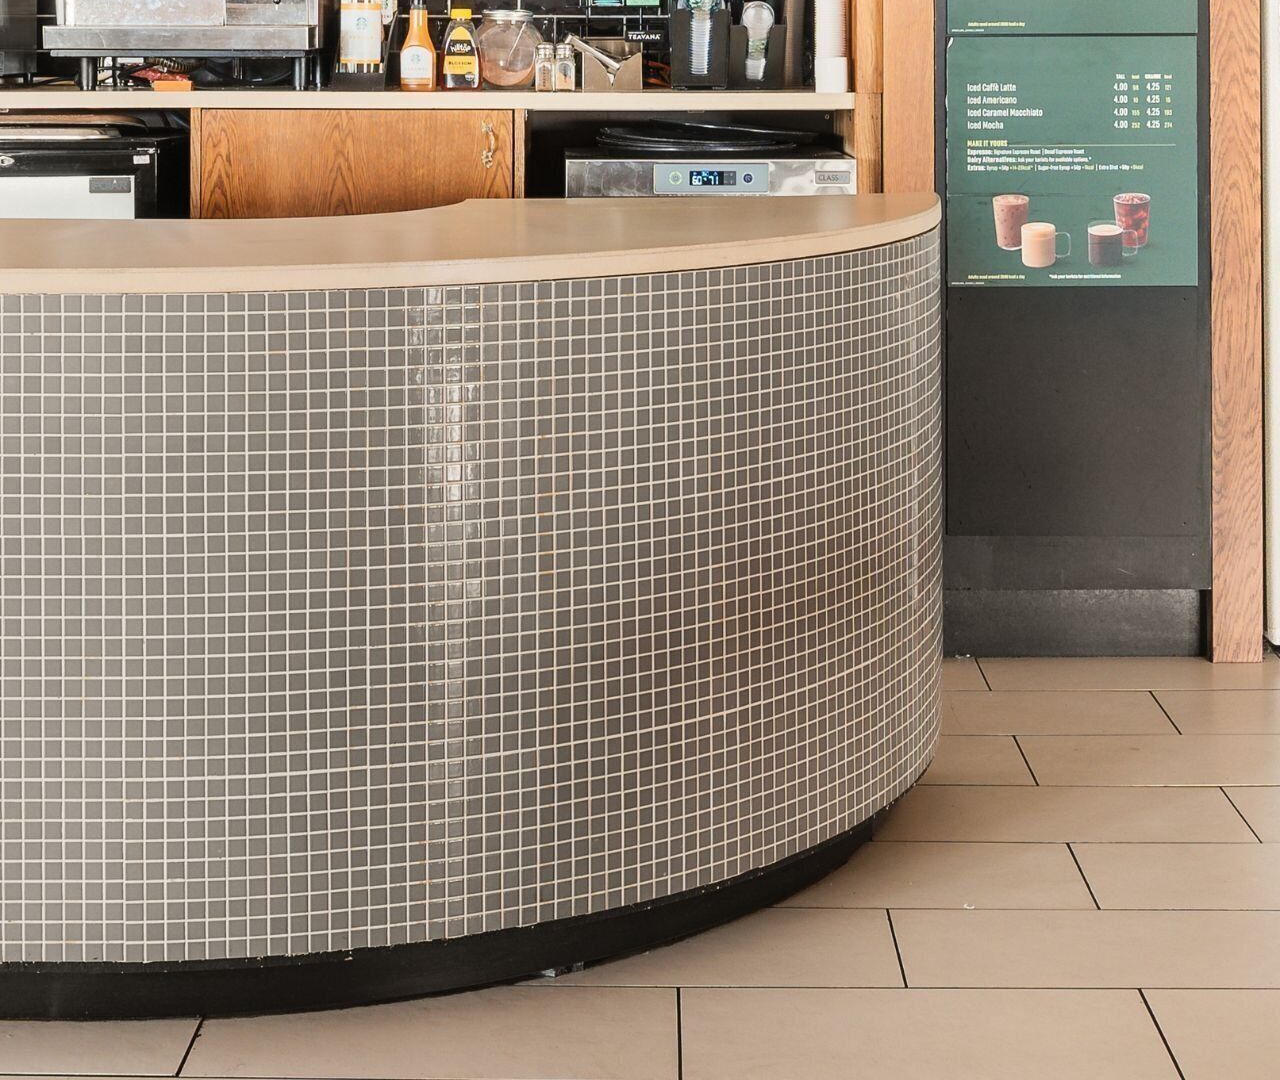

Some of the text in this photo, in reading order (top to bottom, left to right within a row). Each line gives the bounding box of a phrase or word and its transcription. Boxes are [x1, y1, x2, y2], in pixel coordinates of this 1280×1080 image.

[1114, 82, 1128, 90] 4.00
[1146, 82, 1160, 90] 4.25
[968, 96, 981, 104] Iced
[982, 96, 1017, 104] Americano
[1114, 95, 1128, 103] 4.00
[1146, 95, 1160, 103] 4.25
[968, 108, 981, 116] Iced
[982, 108, 1008, 116] Caramel
[1010, 108, 1043, 116] Macchiato
[1114, 108, 1128, 116] 4.00
[1146, 108, 1160, 116] 4.25
[968, 121, 981, 129] Iced
[982, 121, 1004, 129] Mocha
[1114, 120, 1128, 128] 4.00
[1146, 120, 1160, 128] 4.25
